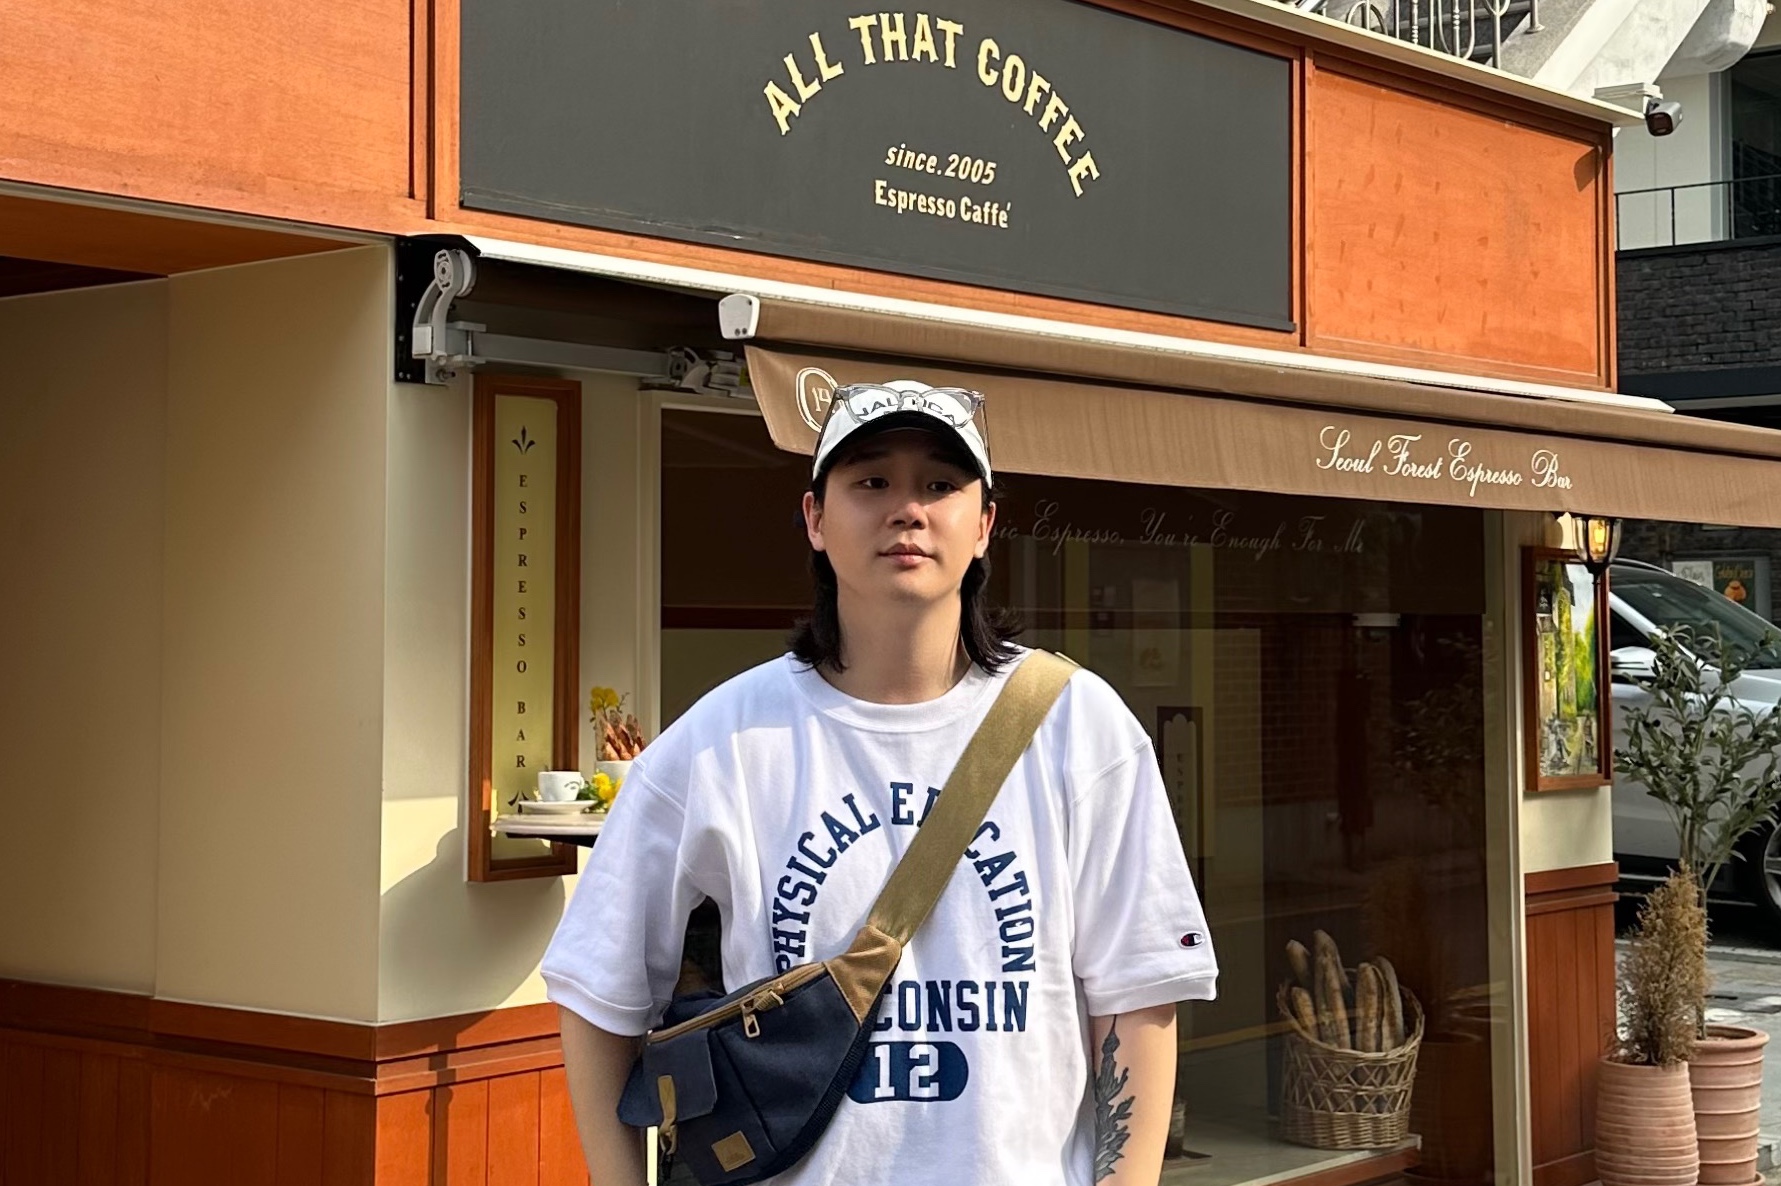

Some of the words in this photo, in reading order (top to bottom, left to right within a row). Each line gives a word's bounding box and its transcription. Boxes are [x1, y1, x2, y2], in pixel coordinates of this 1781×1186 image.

[764, 32, 844, 135] ALL
[848, 12, 964, 68] THAT
[977, 38, 1100, 197] COFFEE
[875, 179, 956, 219] Espresso
[1316, 425, 1382, 473] Seoul
[1383, 434, 1443, 479] Forest
[1448, 438, 1523, 498] Espresso
[1531, 449, 1573, 489] Bar
[1211, 508, 1282, 562] Enough
[1292, 513, 1328, 551] For
[516, 474, 528, 674] ESPRESSO
[516, 701, 527, 768] BAR
[772, 793, 881, 974] PHYSICAL
[890, 782, 1036, 972] ECATION
[873, 980, 1029, 1032] CONSIN
[874, 1044, 940, 1099] 12
